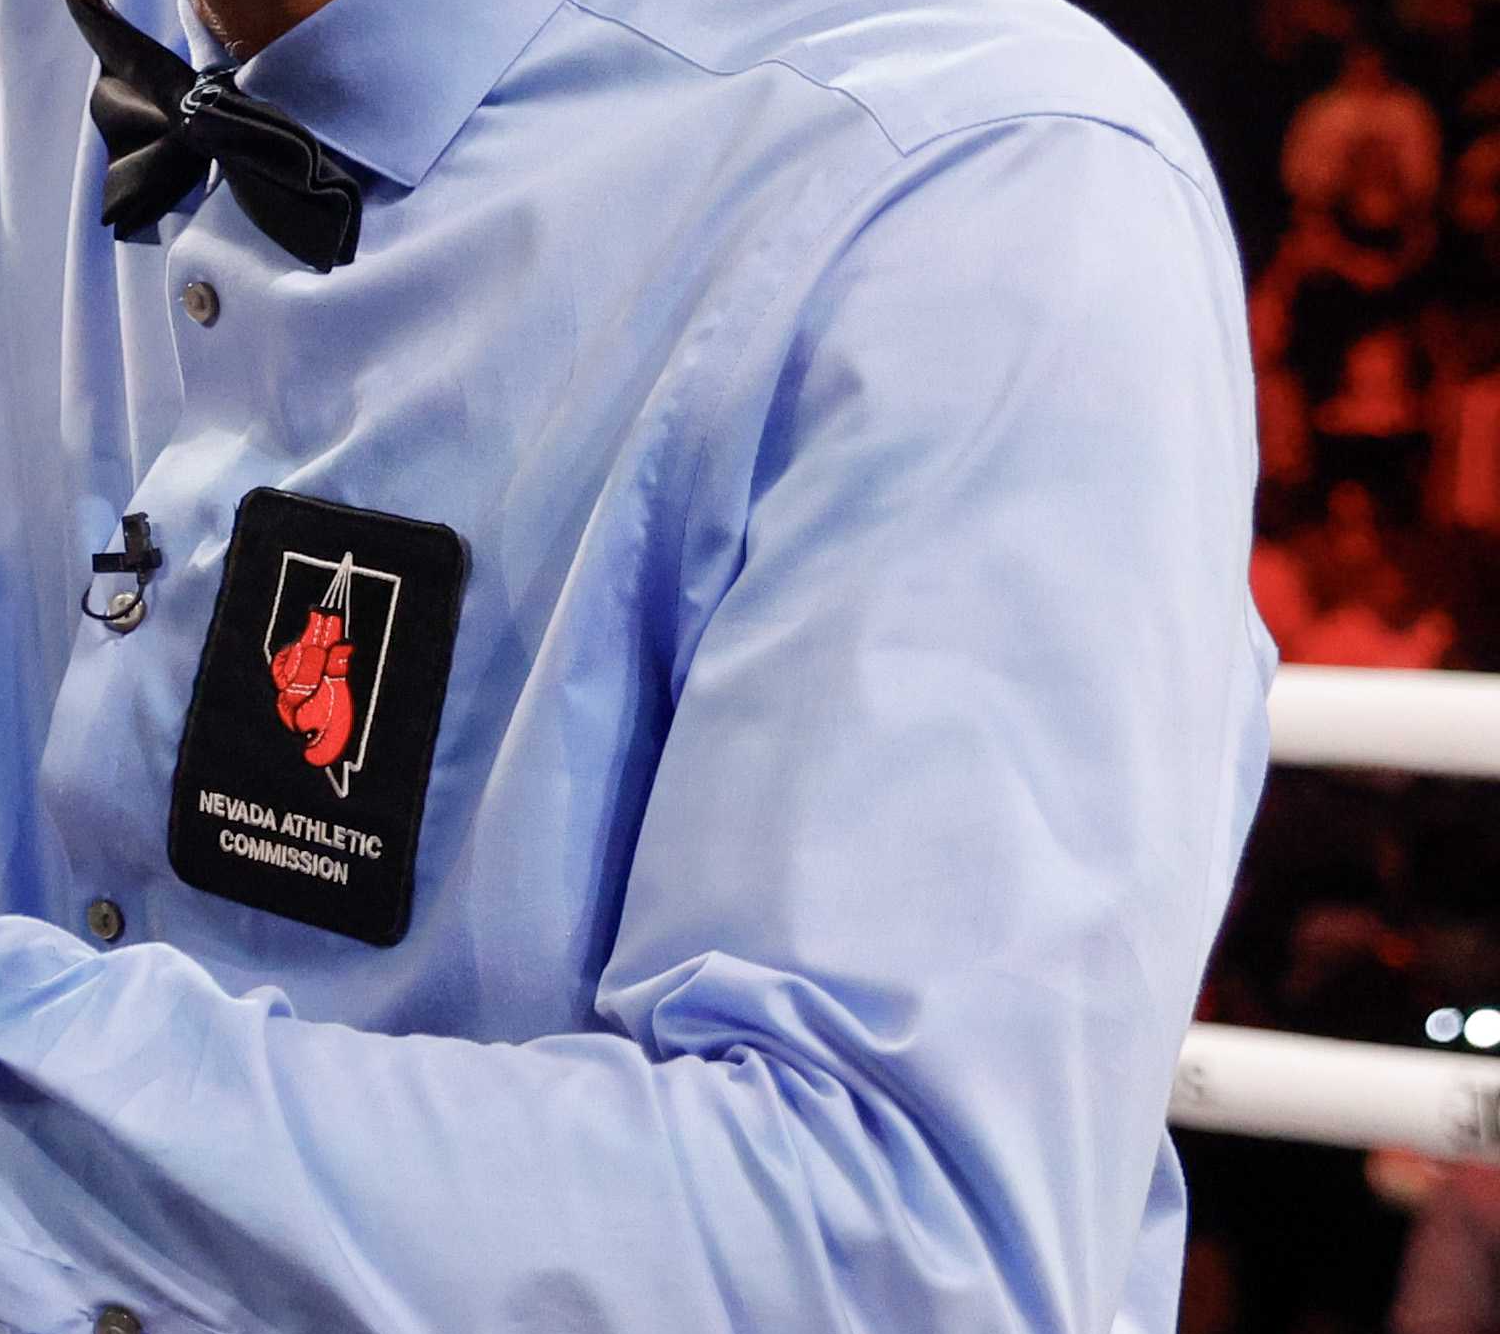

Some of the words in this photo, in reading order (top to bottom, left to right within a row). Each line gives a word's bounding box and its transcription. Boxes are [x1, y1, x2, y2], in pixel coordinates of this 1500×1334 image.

[199, 789, 278, 833] NEVADA
[280, 811, 384, 860] ATHLETIC
[219, 828, 350, 886] COMMISSION
